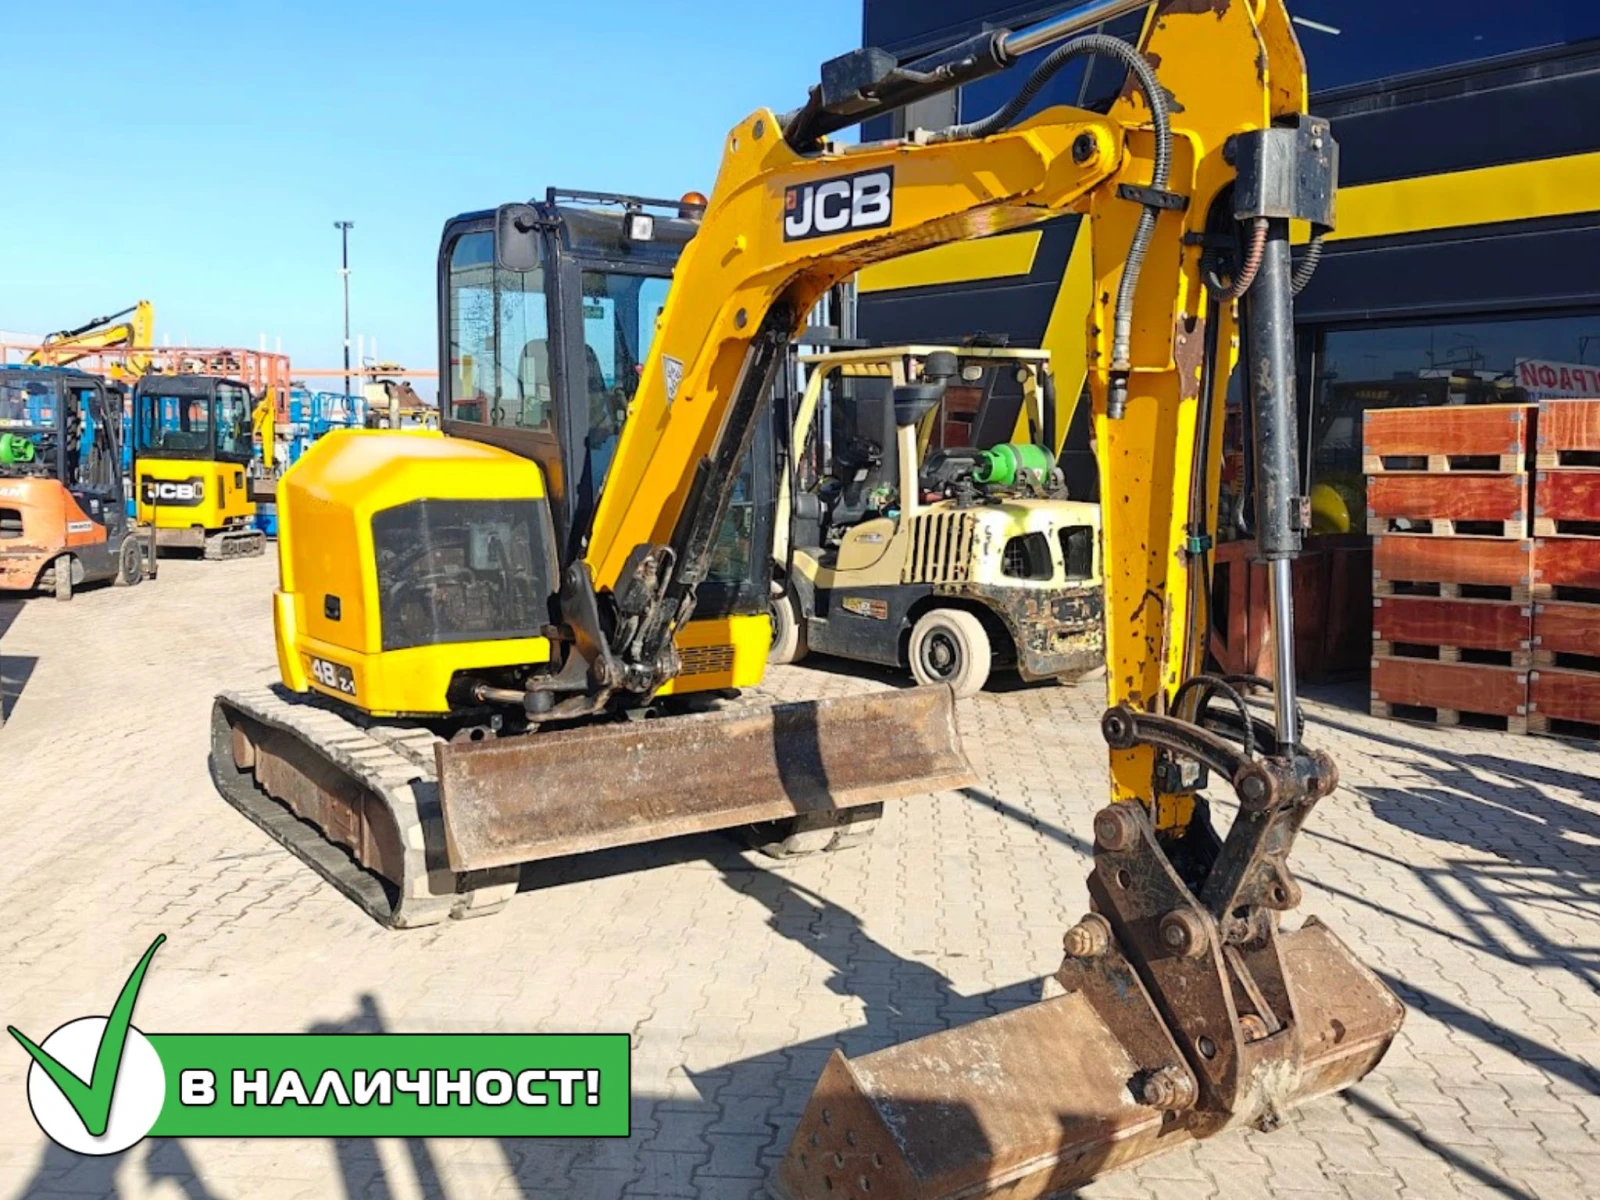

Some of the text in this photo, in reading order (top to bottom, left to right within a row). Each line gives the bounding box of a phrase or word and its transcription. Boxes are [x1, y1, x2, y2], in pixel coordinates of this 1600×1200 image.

[785, 172, 891, 237] JCB
[147, 482, 194, 499] JCB
[312, 659, 337, 687] 48
